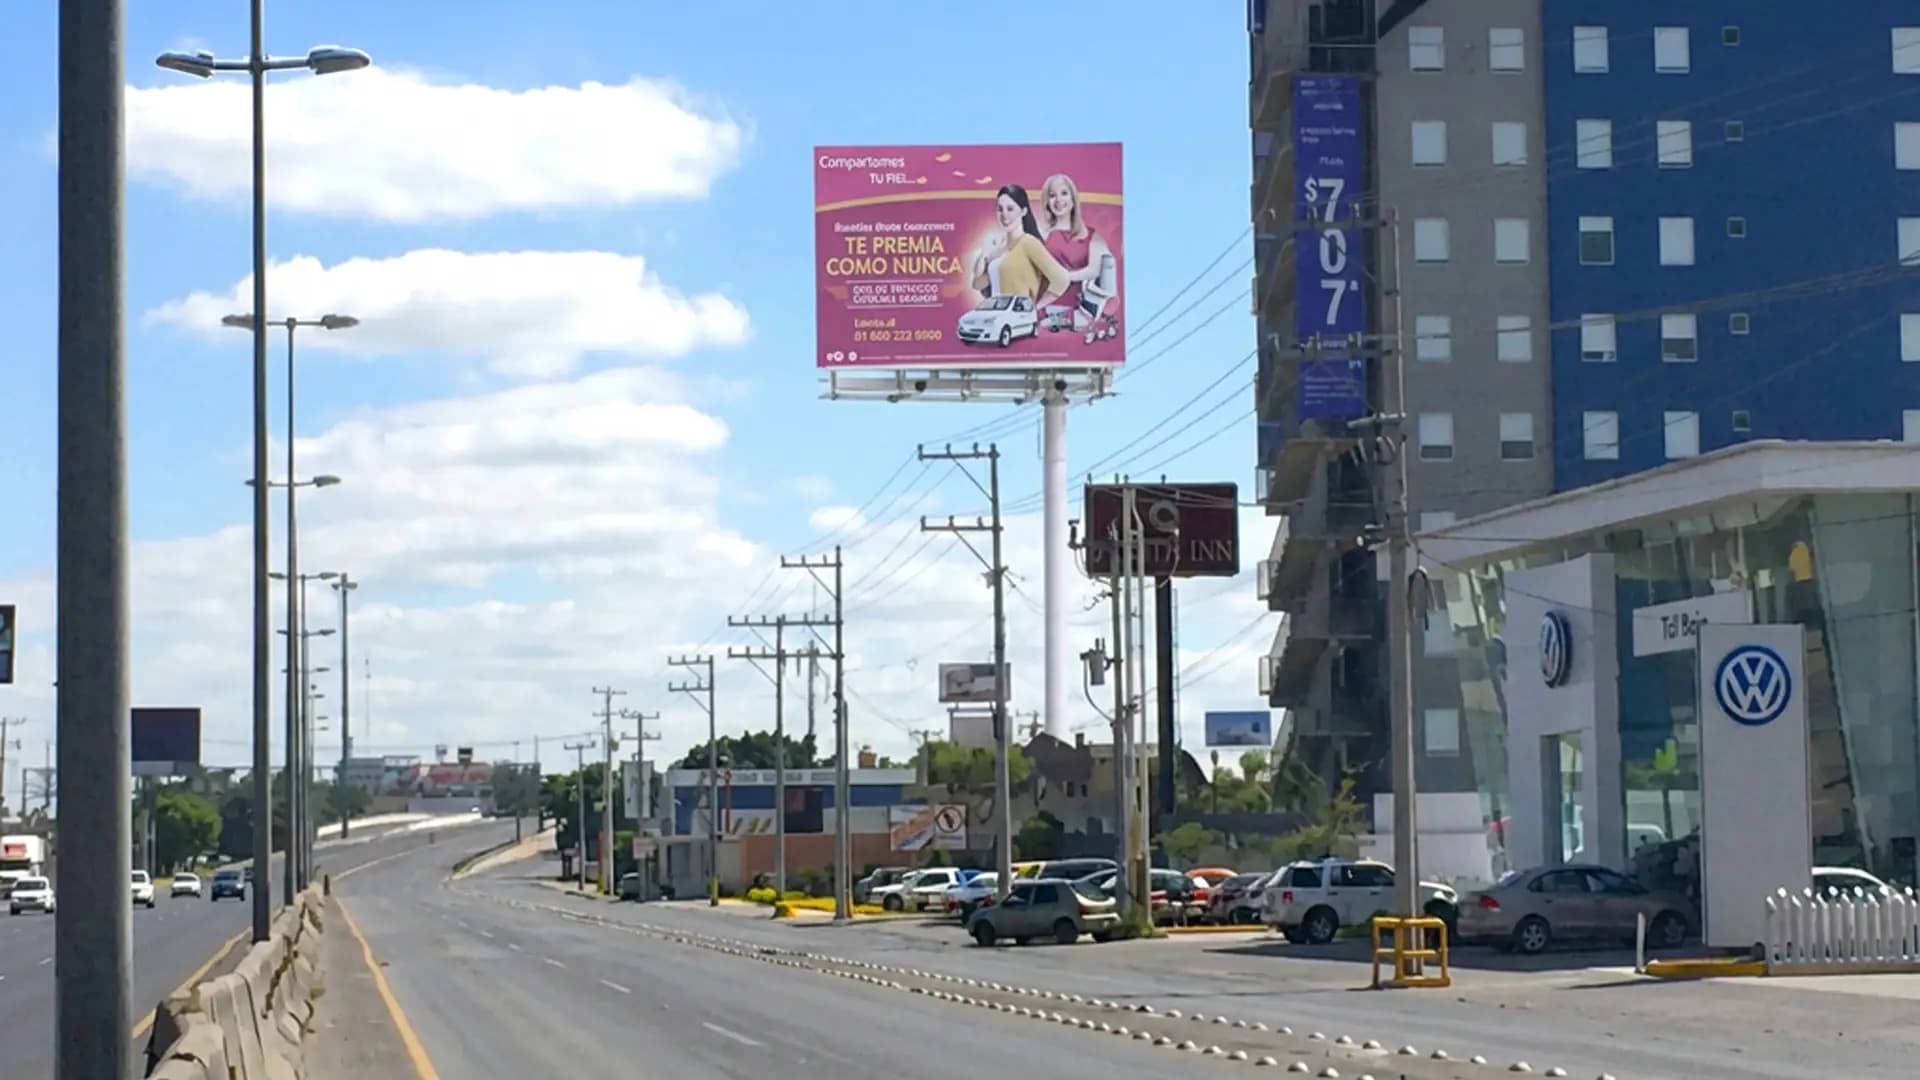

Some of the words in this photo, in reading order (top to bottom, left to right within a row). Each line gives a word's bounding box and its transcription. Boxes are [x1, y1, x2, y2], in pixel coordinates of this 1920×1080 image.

[845, 237, 867, 254] TE
[873, 236, 944, 254] PREMIA
[826, 257, 888, 275] COMO
[893, 256, 963, 274] NUNCA
[1191, 539, 1232, 561] INN
